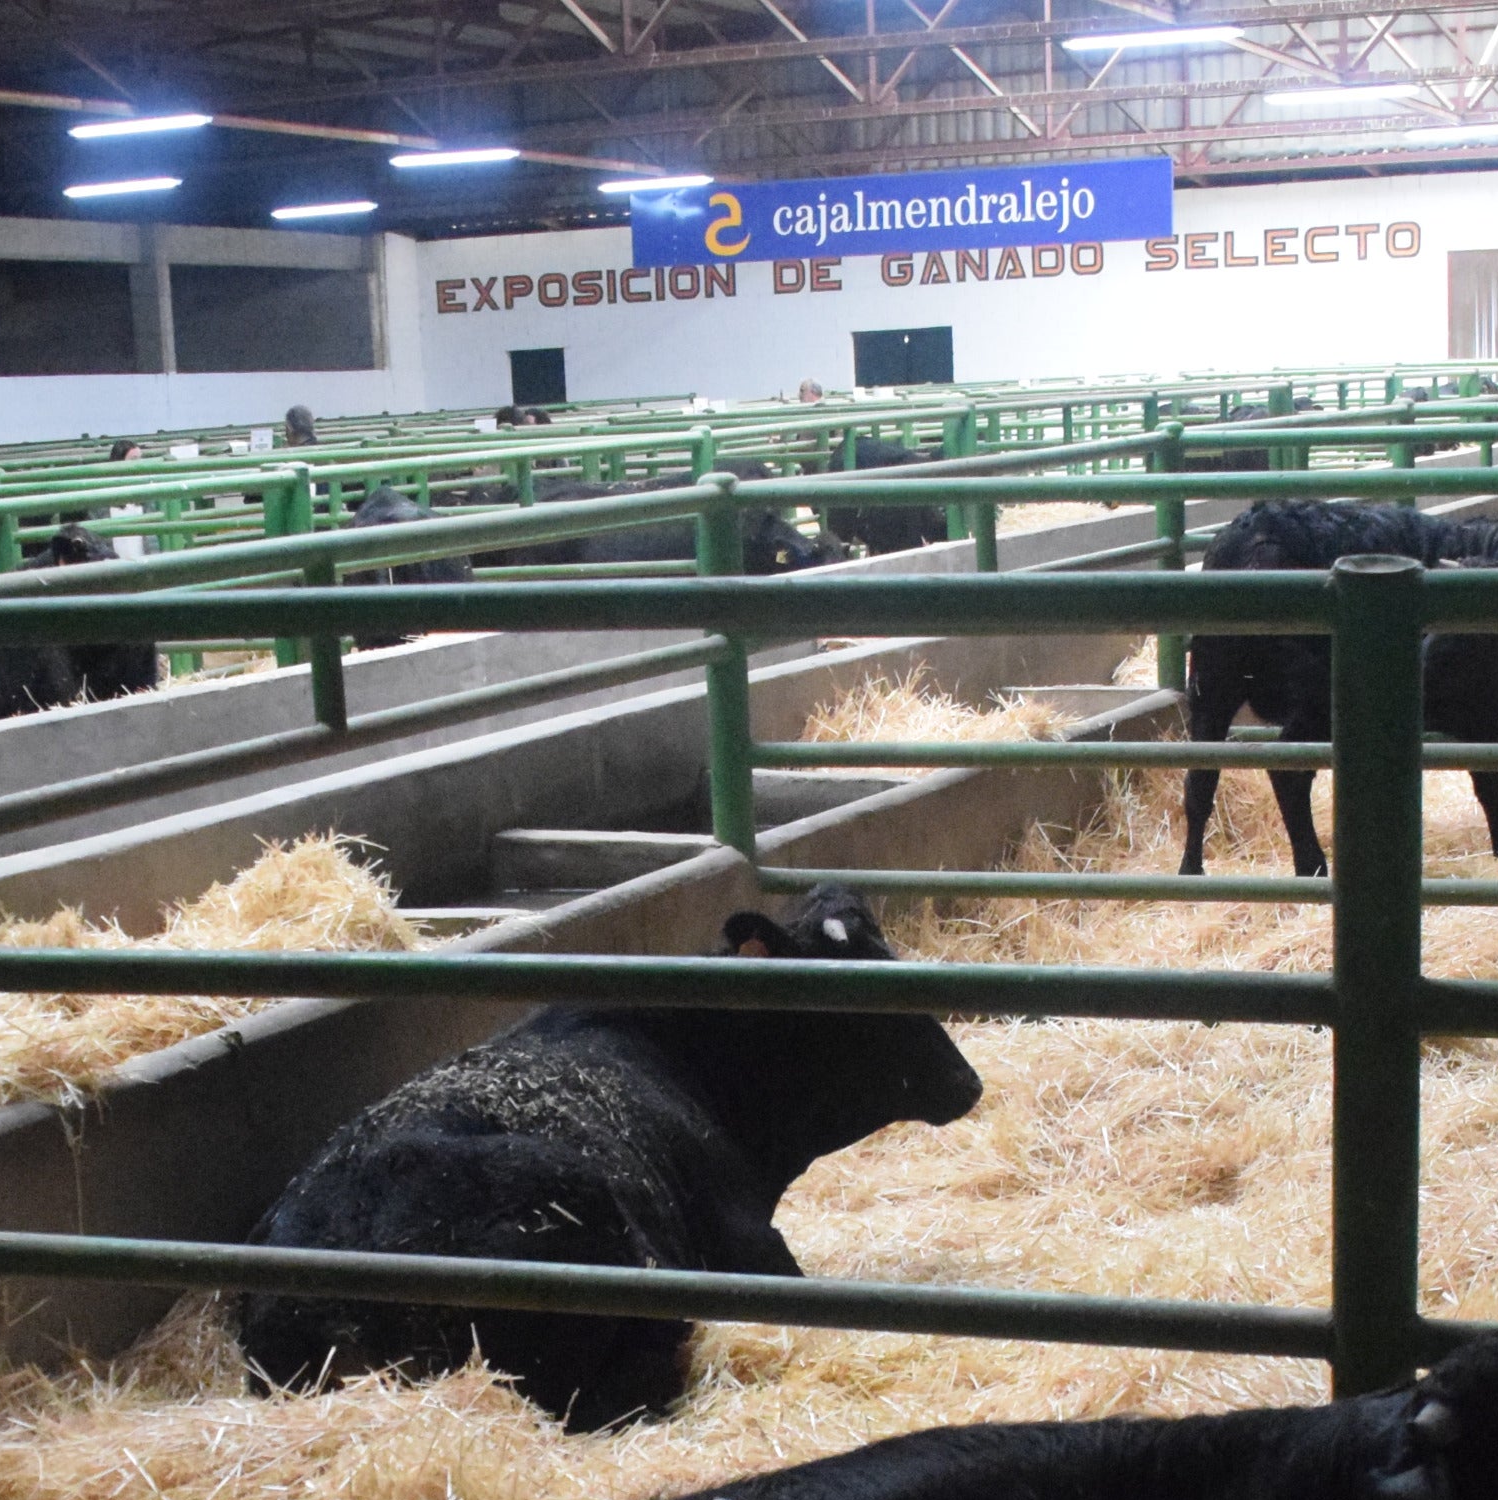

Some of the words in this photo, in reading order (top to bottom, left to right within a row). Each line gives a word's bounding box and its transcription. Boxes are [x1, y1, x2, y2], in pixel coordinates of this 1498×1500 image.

[772, 177, 1095, 246] cajalmendralejo
[436, 263, 737, 314] EXPOSICION
[773, 256, 843, 295] DE
[881, 242, 1104, 288] GANADO
[1145, 221, 1421, 272] SELECTO
